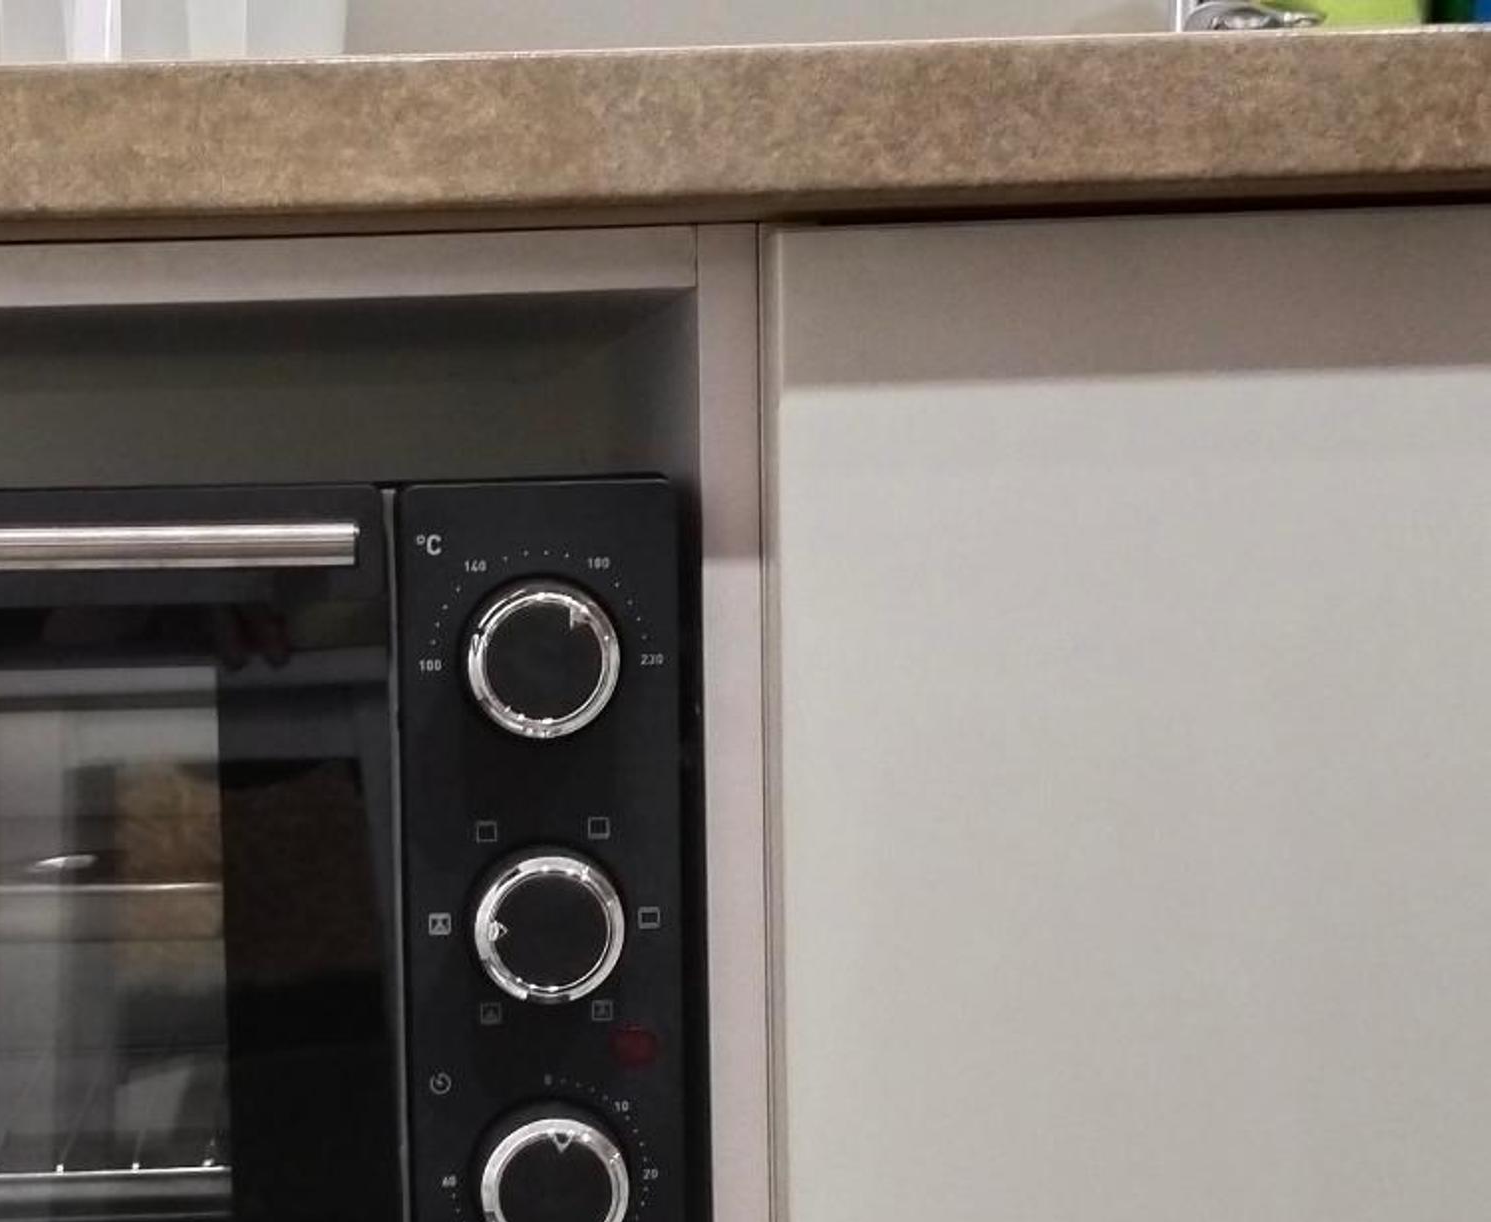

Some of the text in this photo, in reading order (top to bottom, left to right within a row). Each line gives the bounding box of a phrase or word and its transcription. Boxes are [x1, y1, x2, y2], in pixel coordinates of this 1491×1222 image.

[464, 560, 487, 573] 140
[588, 557, 610, 569] 180
[419, 659, 442, 671] 100
[640, 653, 664, 665] 230
[614, 1100, 629, 1112] 10
[643, 1168, 659, 1180] 20
